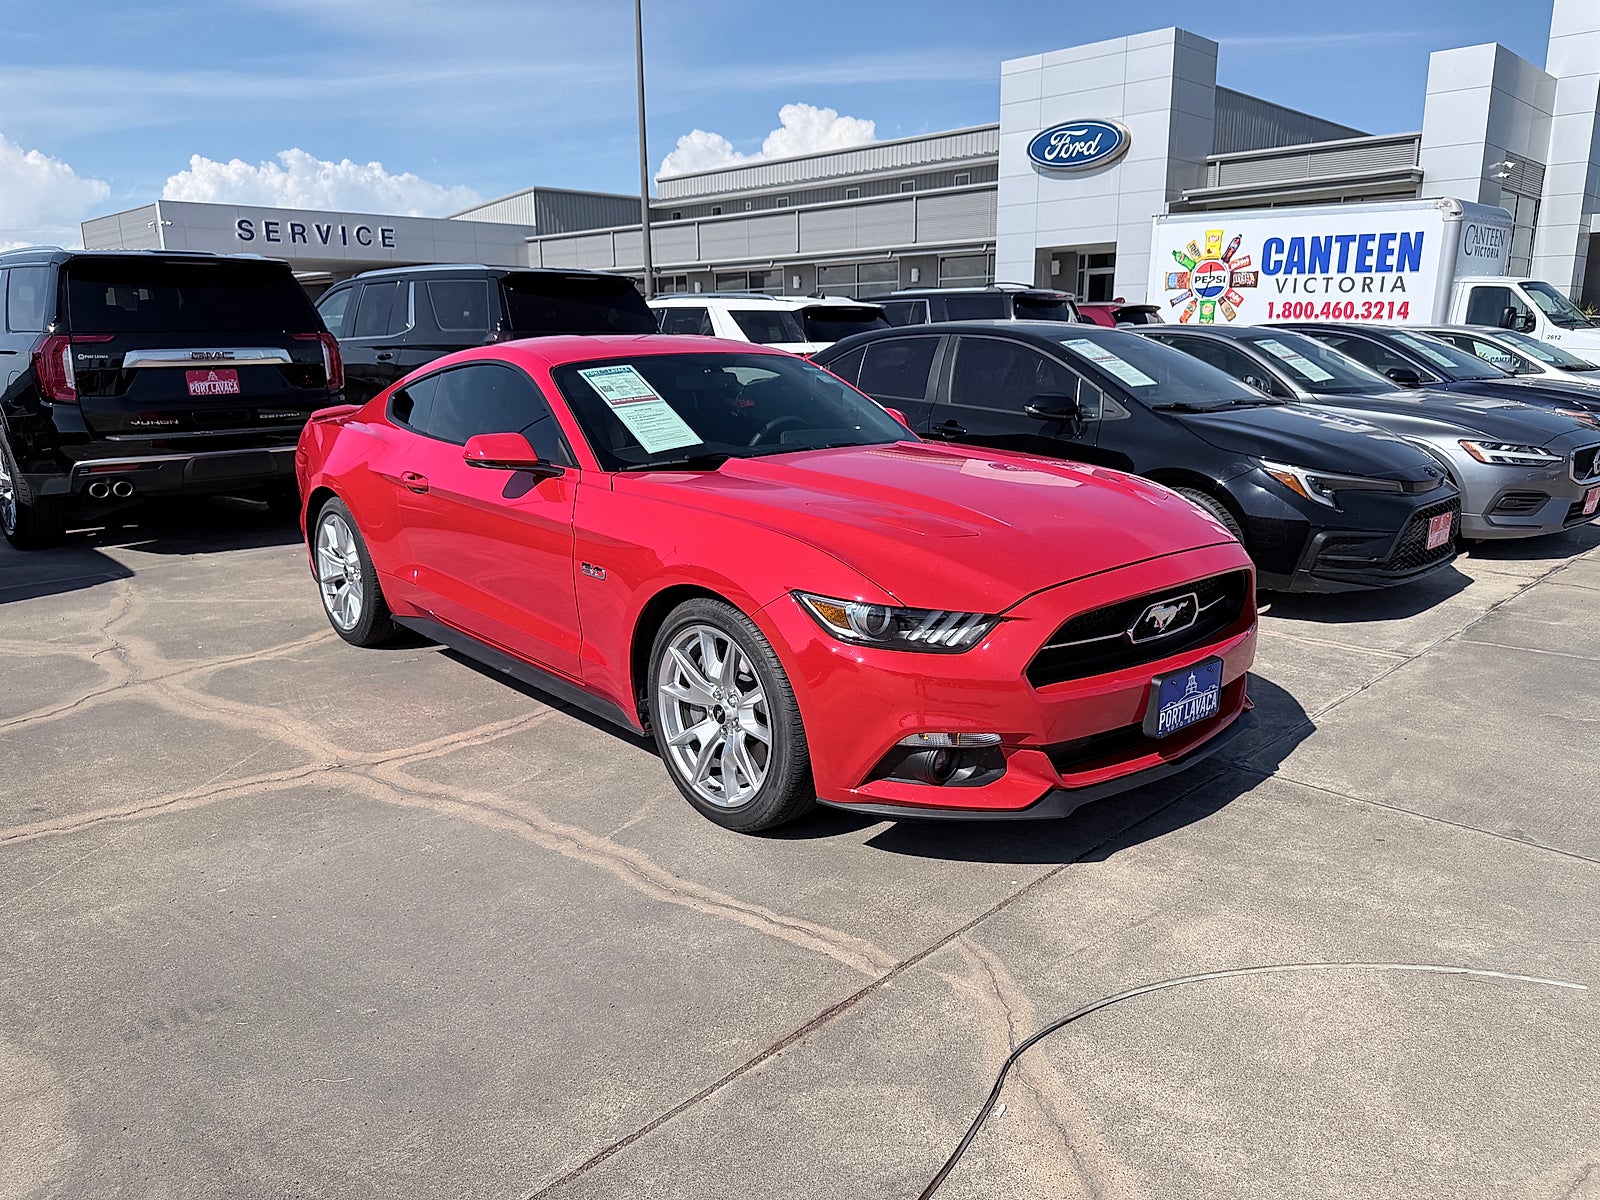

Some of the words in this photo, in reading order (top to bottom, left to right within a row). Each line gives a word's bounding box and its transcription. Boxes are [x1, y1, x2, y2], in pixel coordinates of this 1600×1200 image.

[1044, 128, 1102, 160] Ford
[235, 218, 396, 249] SERVICE
[1464, 224, 1506, 256] CANTEEN
[1261, 231, 1425, 276] CANTEEN
[1474, 245, 1499, 259] VICTORIA
[1275, 276, 1407, 294] VICTORIA
[1267, 301, 1410, 320] 1.800.460.3214
[189, 382, 209, 393] PORT
[210, 381, 239, 392] LAVACA
[1159, 705, 1184, 731] PORT
[1184, 691, 1217, 720] LAVACA
